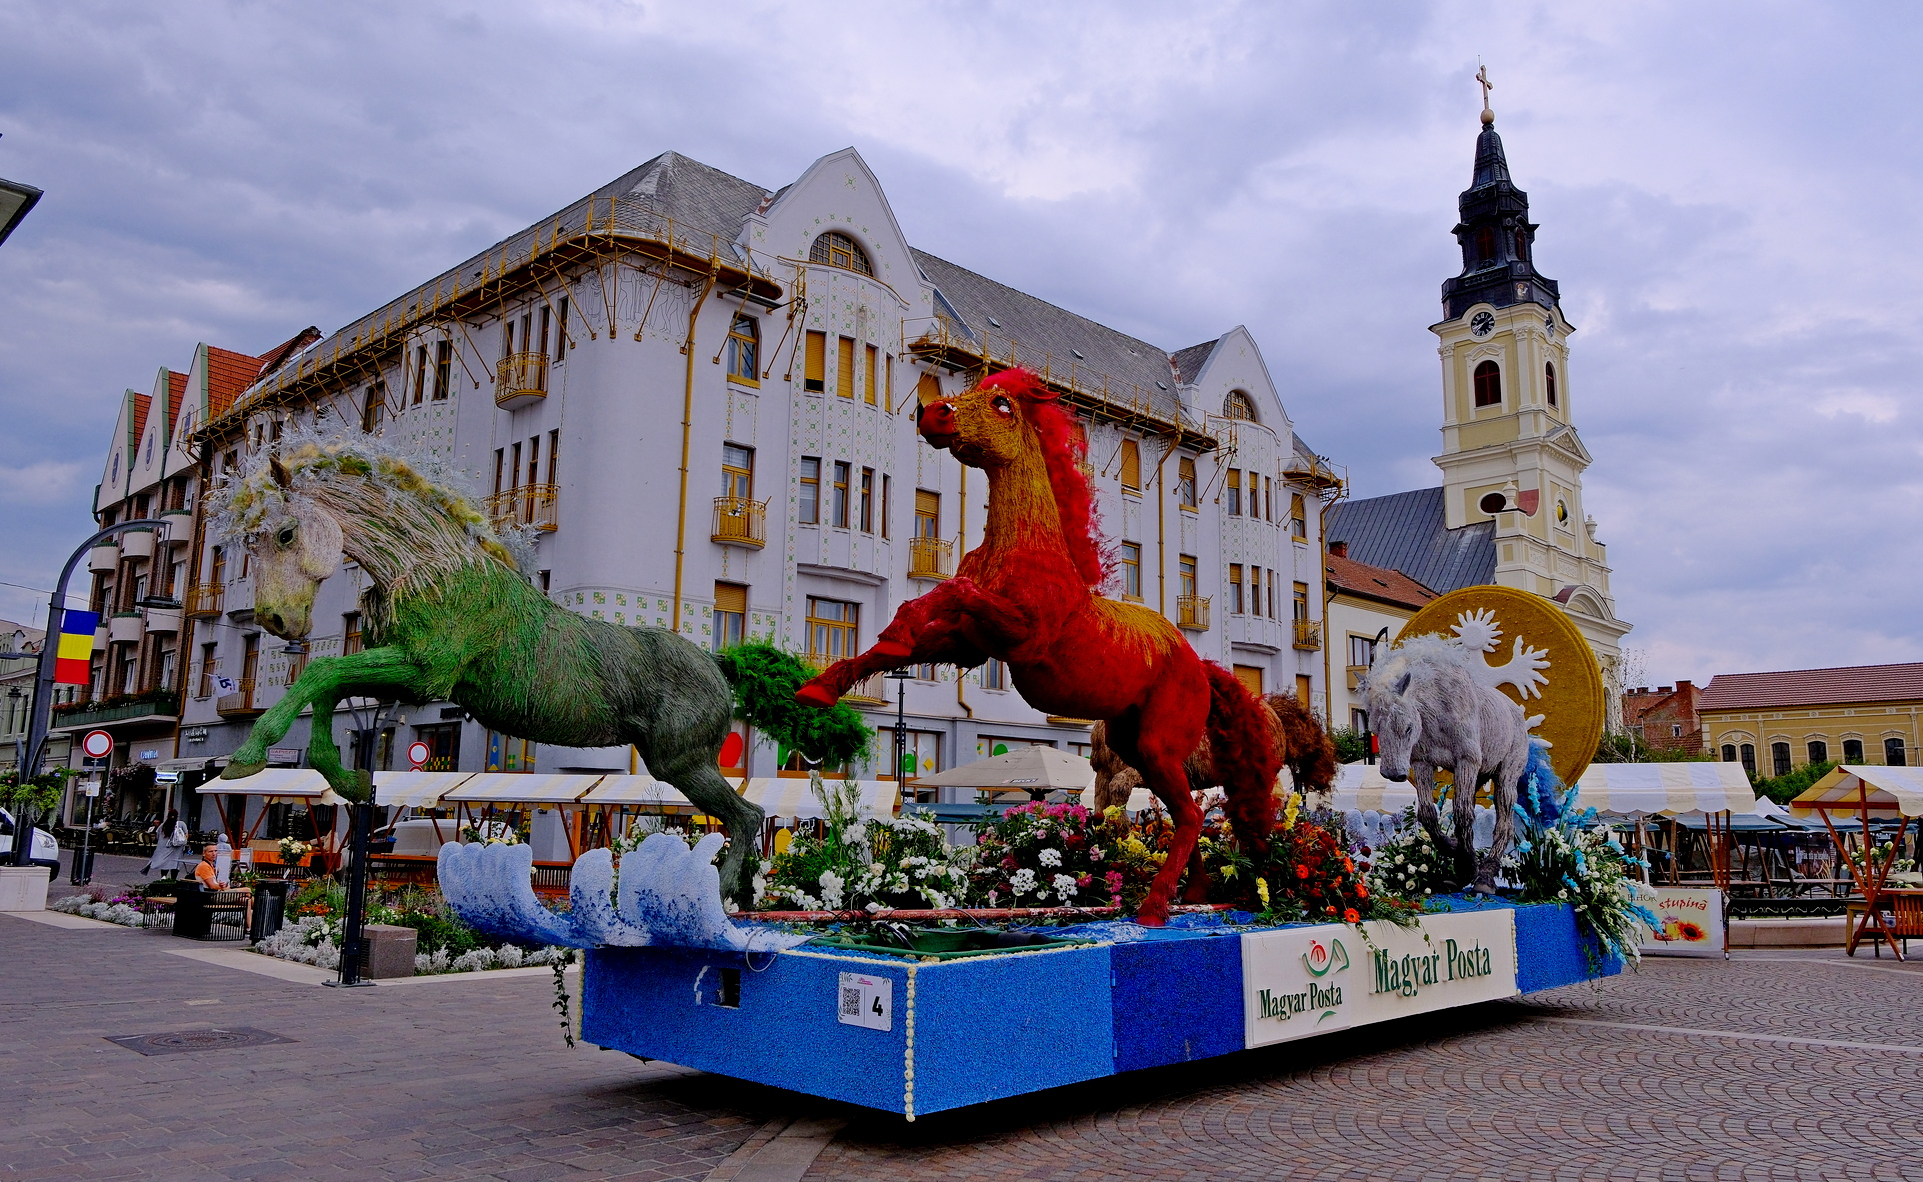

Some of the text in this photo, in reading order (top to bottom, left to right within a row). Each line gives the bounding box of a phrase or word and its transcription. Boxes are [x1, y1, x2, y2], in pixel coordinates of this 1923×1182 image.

[1373, 938, 1492, 998] Magyar Posta
[872, 996, 884, 1017] 4
[1259, 982, 1343, 1021] Magyar Posta
